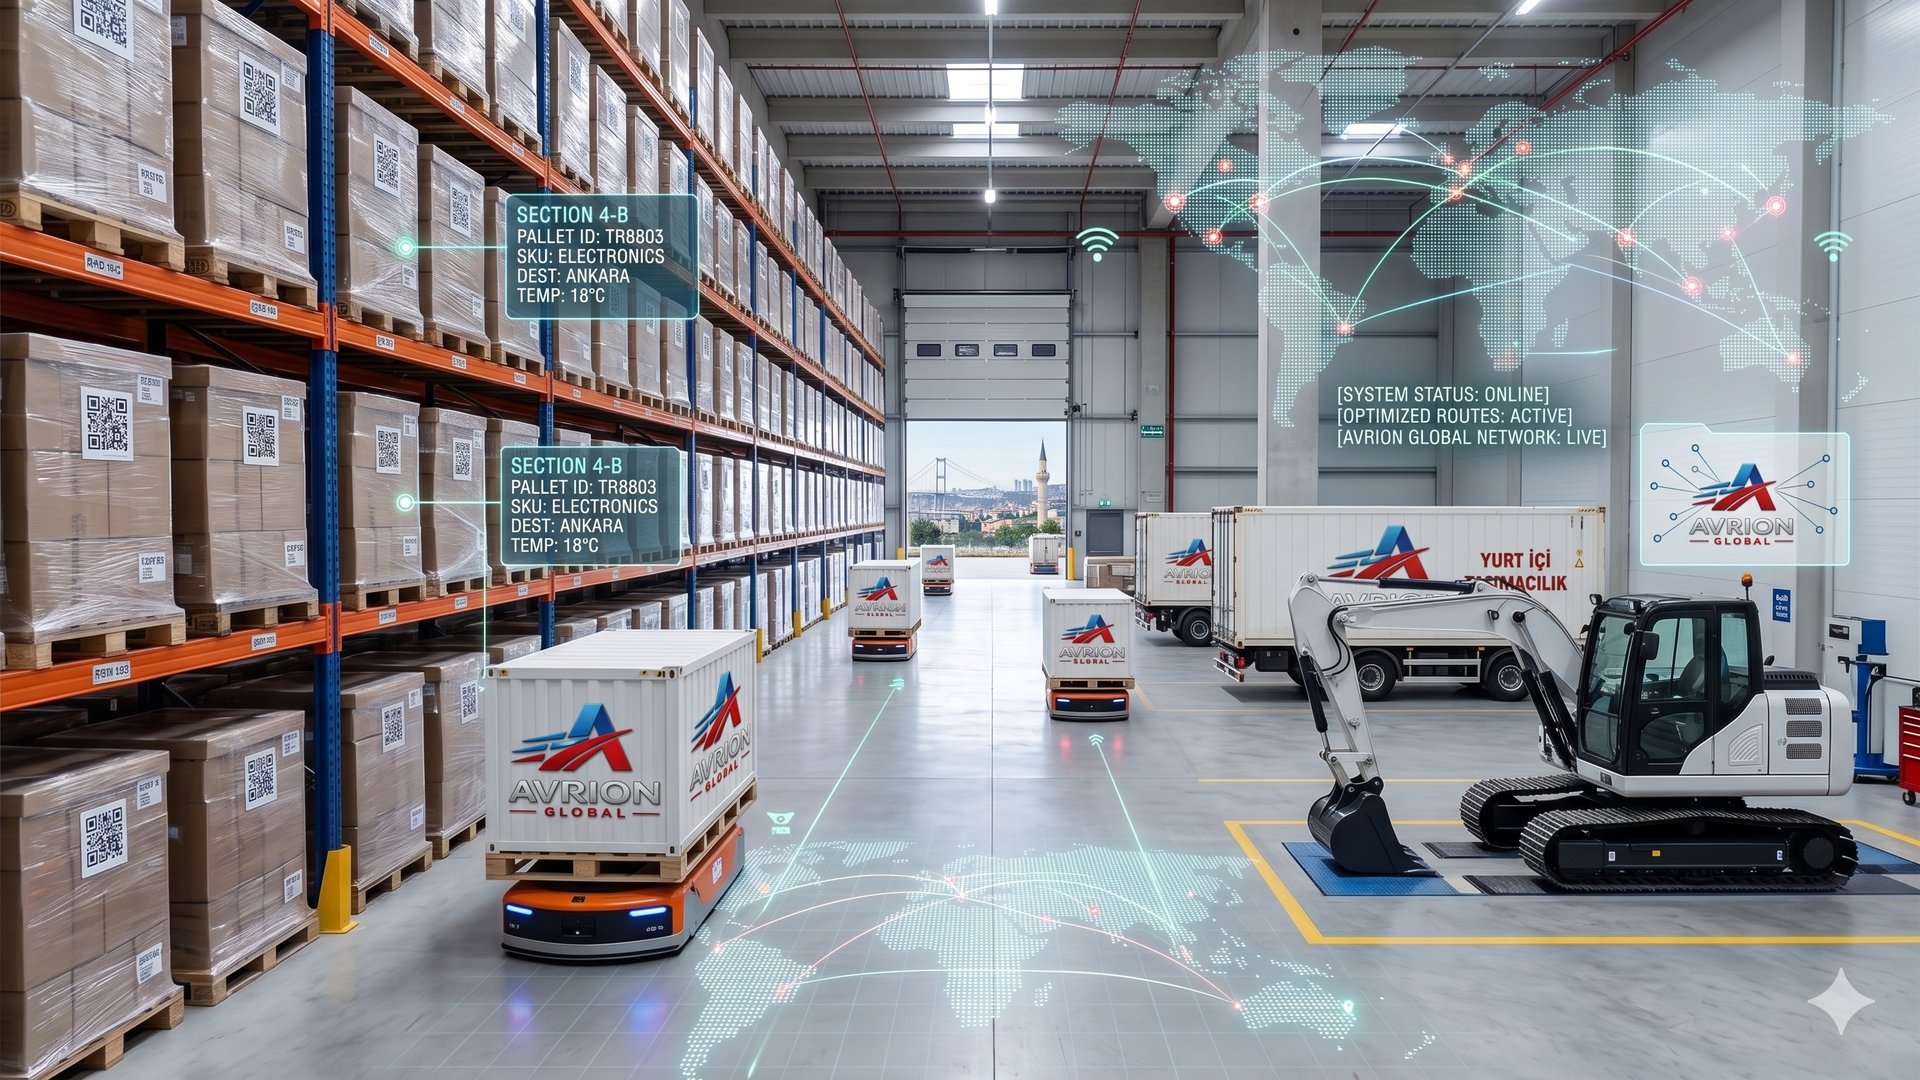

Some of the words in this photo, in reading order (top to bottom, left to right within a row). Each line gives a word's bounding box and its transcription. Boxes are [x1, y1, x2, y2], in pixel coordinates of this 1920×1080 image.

[1480, 552, 1524, 568] YURT
[1529, 548, 1551, 571] İÇİ
[1163, 568, 1212, 579] AVRIO
[1059, 646, 1125, 658] AVRION
[689, 723, 752, 792] AVRION
[705, 760, 739, 793] GLOBAL
[508, 780, 661, 805] AVRION
[544, 807, 626, 818] GLOBAL
